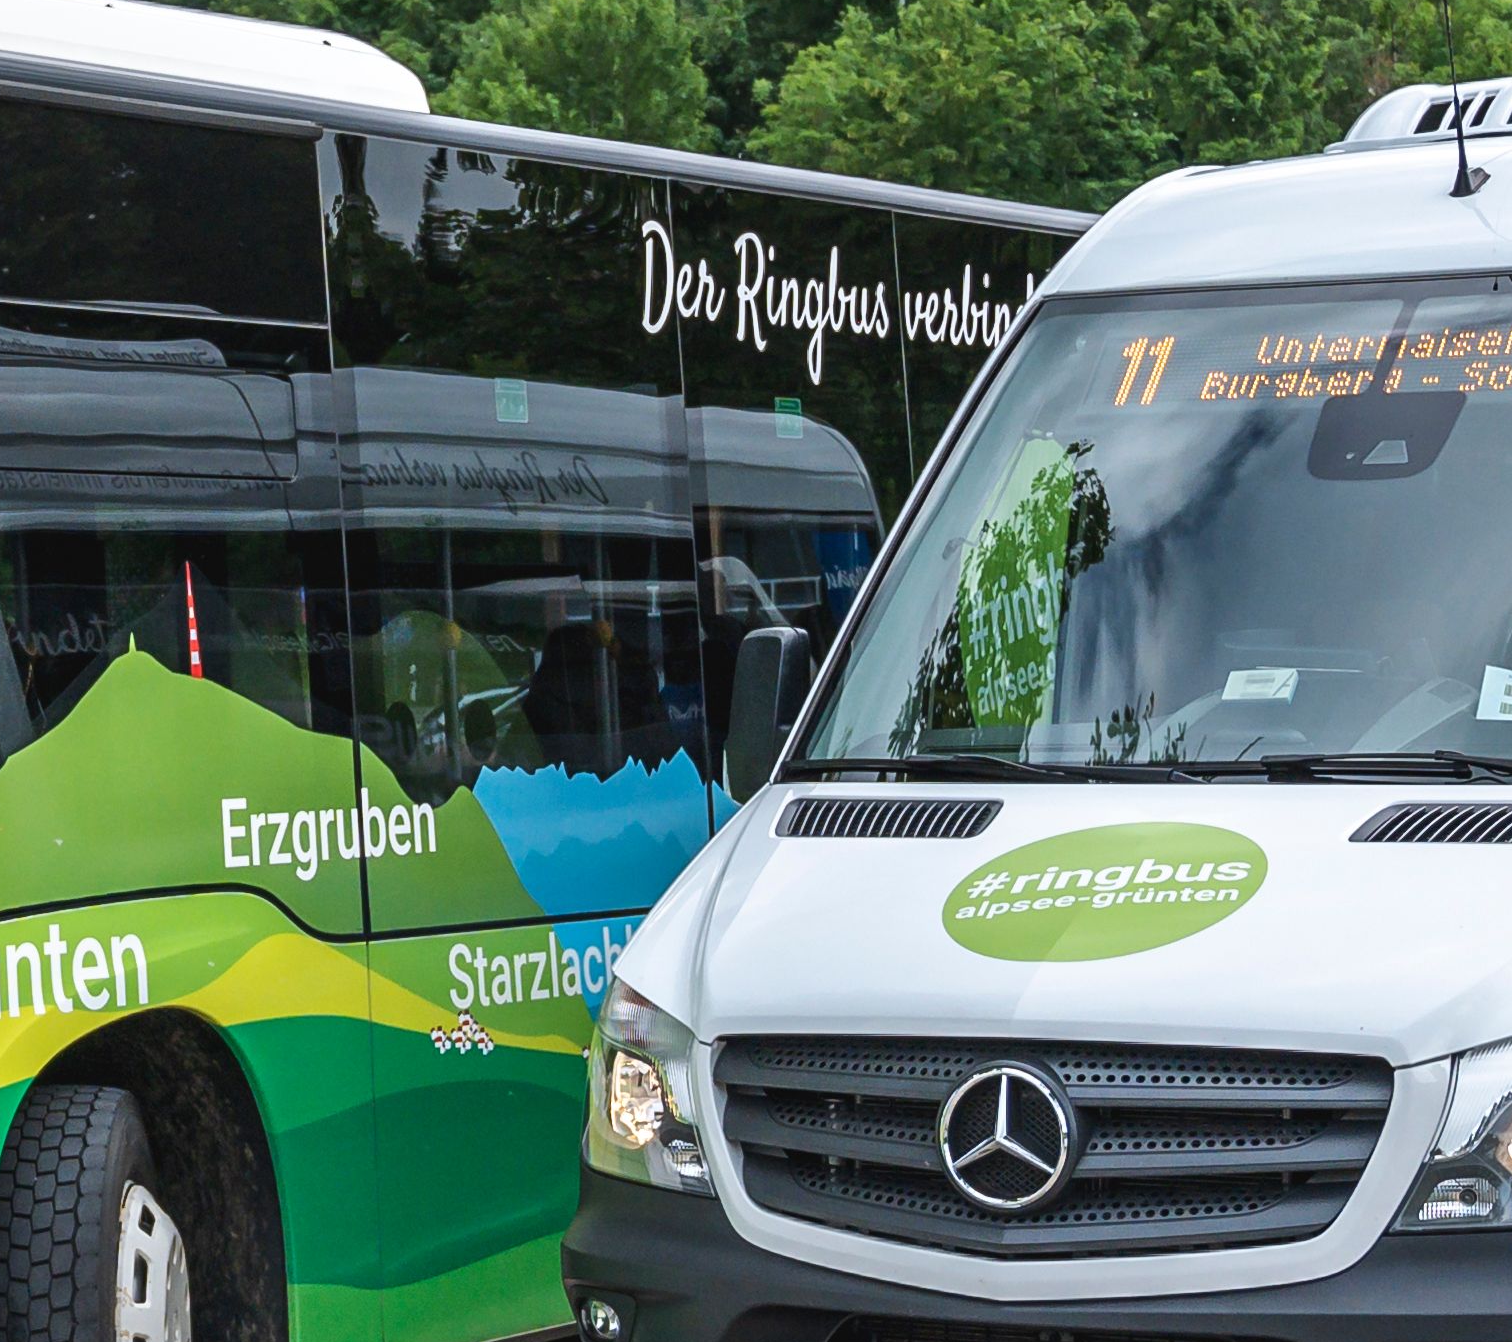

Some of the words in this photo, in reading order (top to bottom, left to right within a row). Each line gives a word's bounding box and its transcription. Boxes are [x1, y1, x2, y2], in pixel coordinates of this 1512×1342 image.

[641, 219, 726, 334] Der
[733, 231, 892, 387] Ringbus
[1114, 336, 1175, 406] 11
[221, 787, 437, 881] Erzgruben
[955, 888, 1240, 920] alpsee-grünten
[967, 859, 1252, 899] #ringbus
